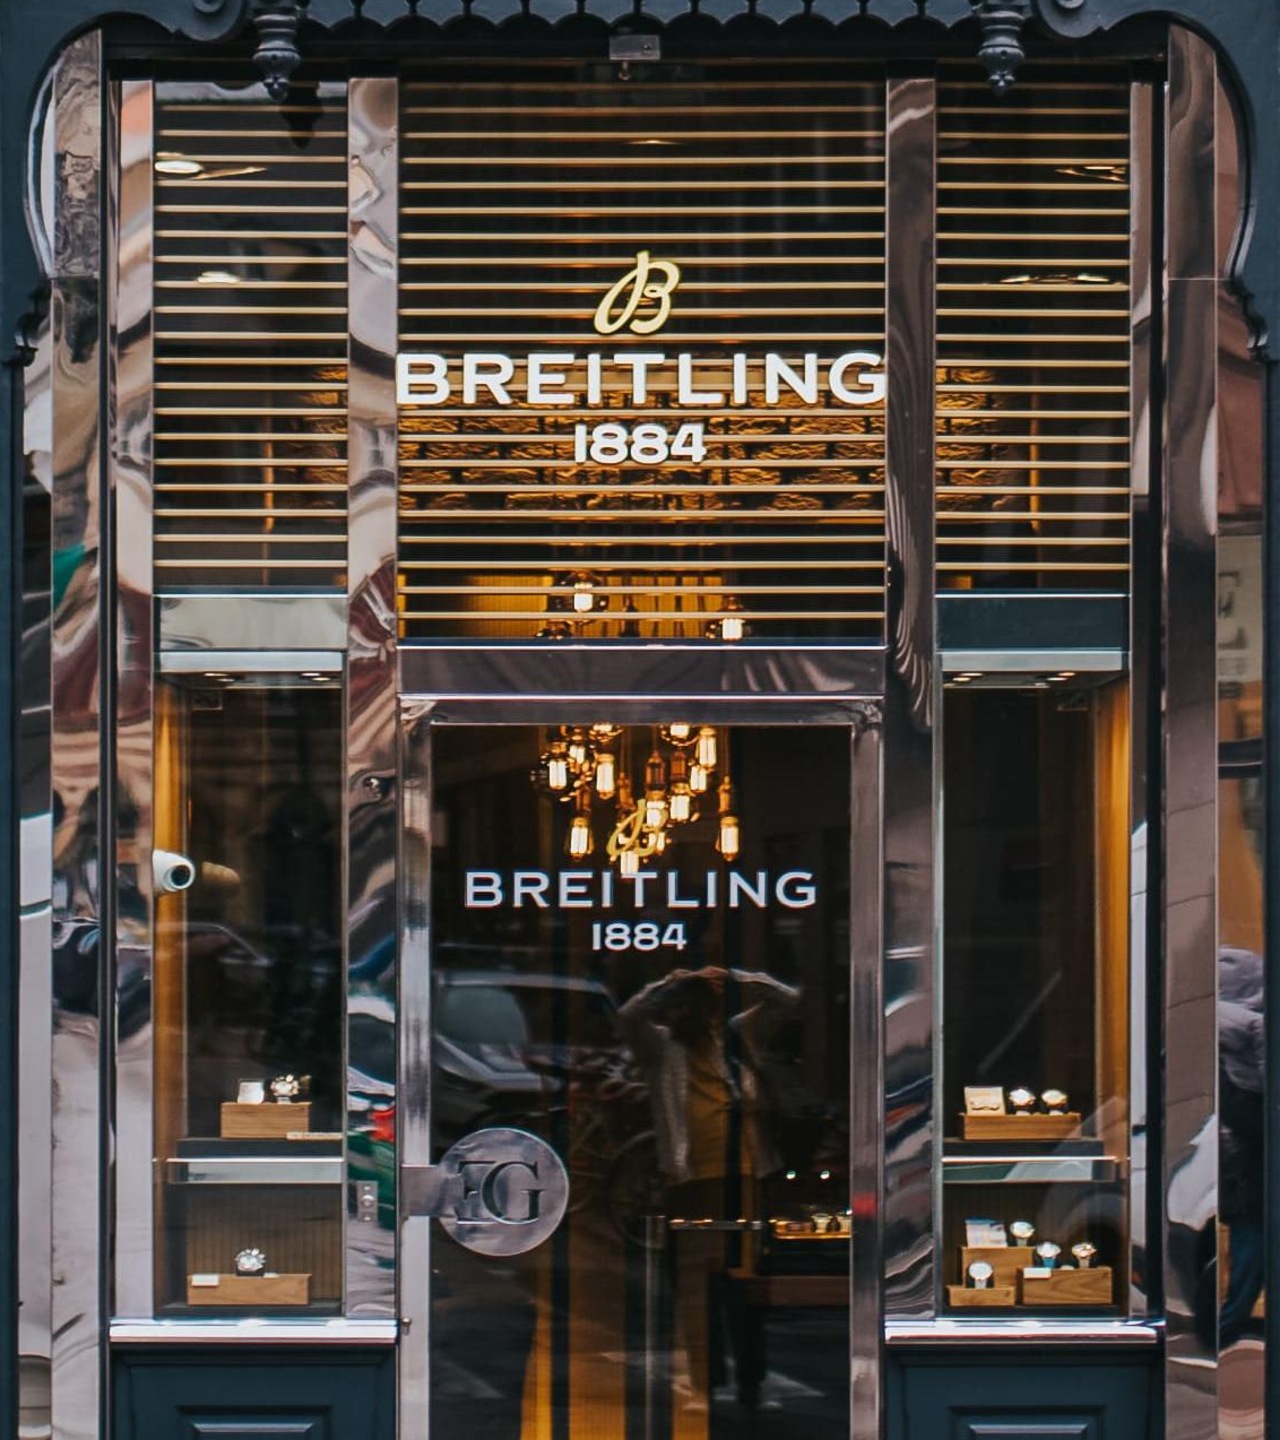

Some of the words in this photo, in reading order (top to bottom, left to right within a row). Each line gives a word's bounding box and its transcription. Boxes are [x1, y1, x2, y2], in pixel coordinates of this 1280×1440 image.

[396, 352, 887, 405] BREITLING
[574, 423, 707, 464] 1884
[466, 871, 817, 908] BREITLING
[592, 923, 687, 951] 1884
